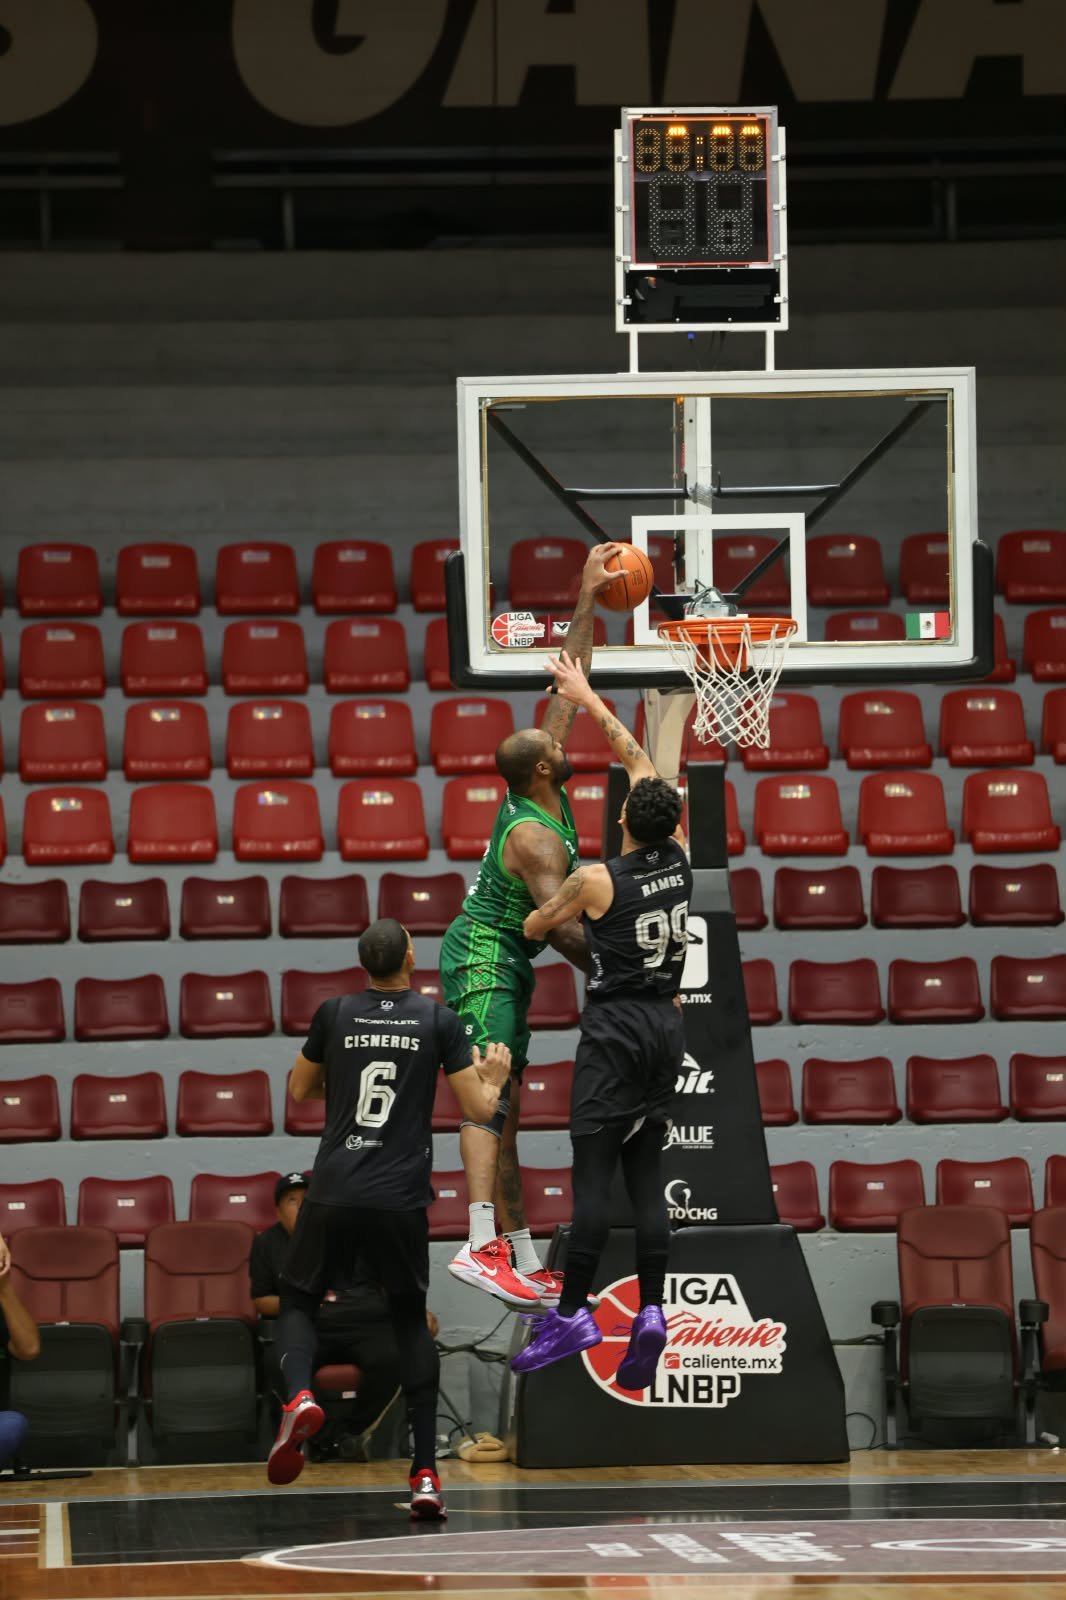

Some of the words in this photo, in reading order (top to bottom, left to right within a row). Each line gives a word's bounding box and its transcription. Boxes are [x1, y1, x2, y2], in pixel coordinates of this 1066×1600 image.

[508, 613, 532, 621] LIGA
[509, 637, 533, 646] LNBP
[641, 874, 685, 897] RAMOS
[344, 1034, 421, 1051] CISNEROS
[355, 1061, 397, 1128] 6
[682, 1355, 777, 1369] caliente.mx
